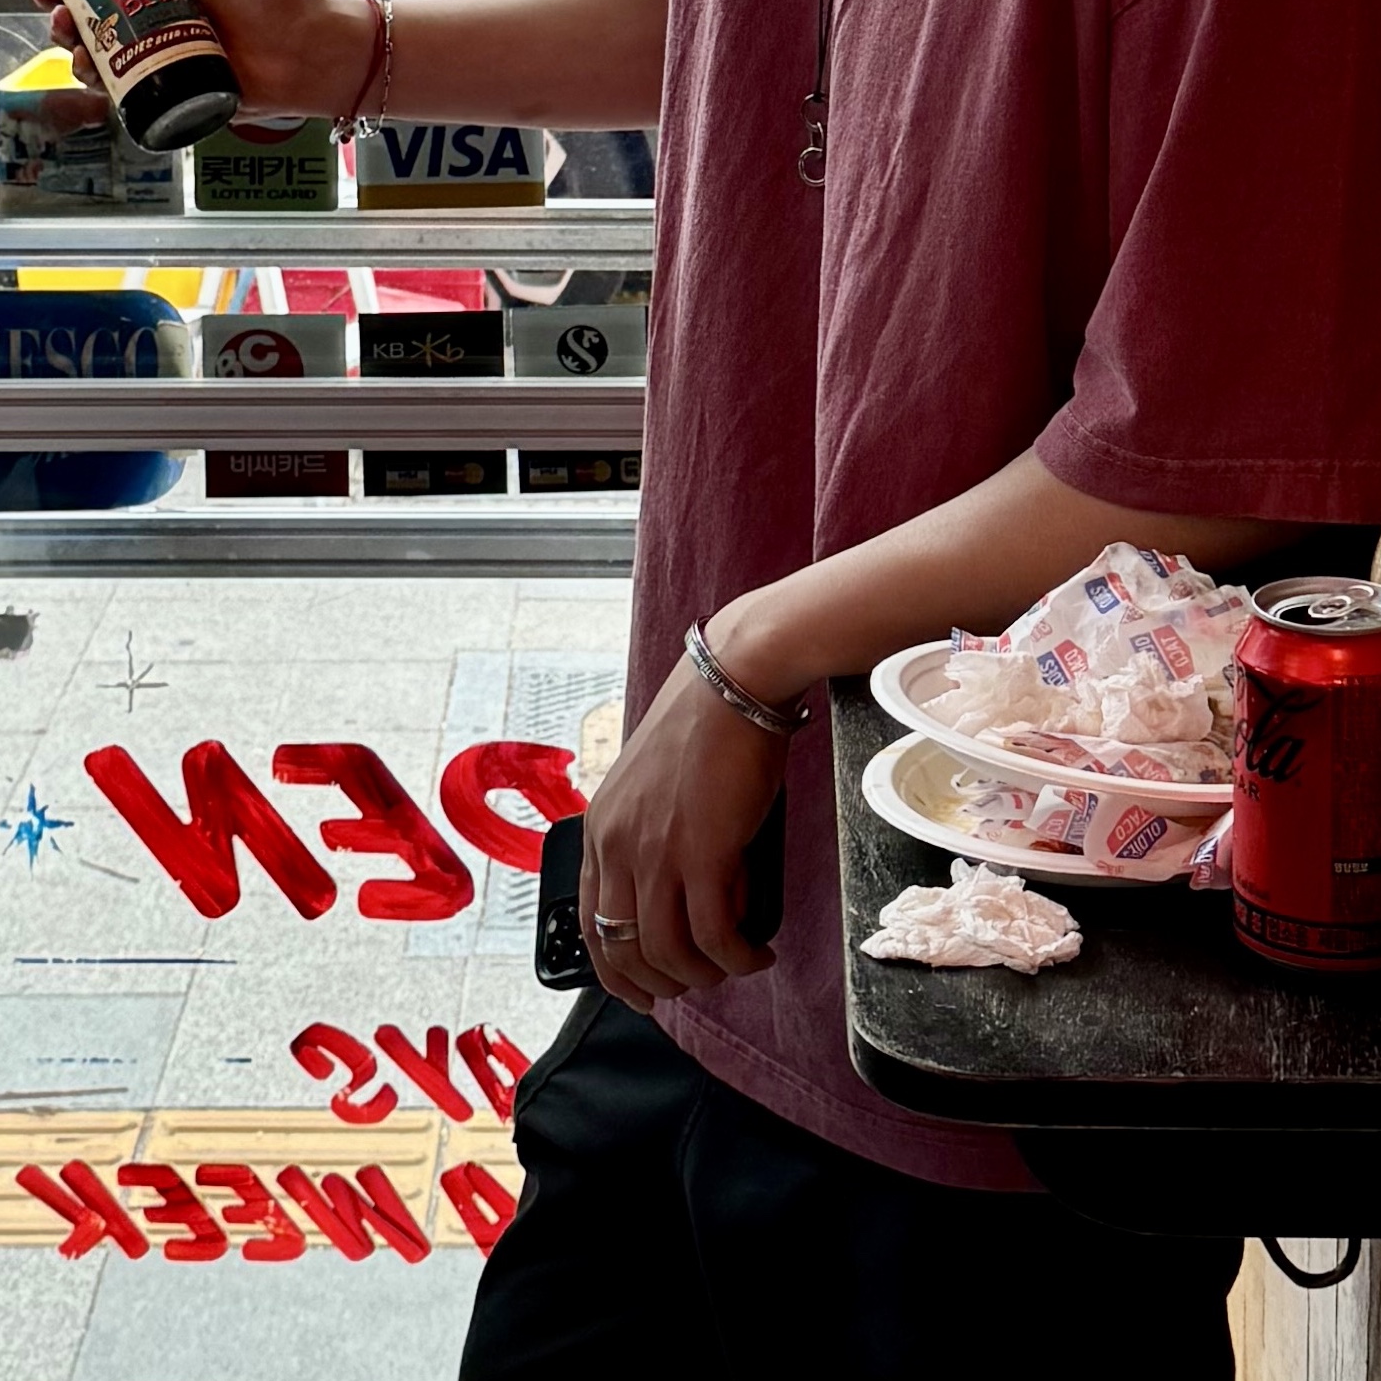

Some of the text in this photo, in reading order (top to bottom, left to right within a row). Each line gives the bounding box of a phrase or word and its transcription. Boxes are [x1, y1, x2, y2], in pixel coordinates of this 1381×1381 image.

[381, 125, 530, 179] VISA
[200, 155, 328, 187] 롯데카드
[211, 188, 318, 201] LOTTE CARD
[372, 343, 405, 359] KB
[229, 453, 327, 478] 비씨카드
